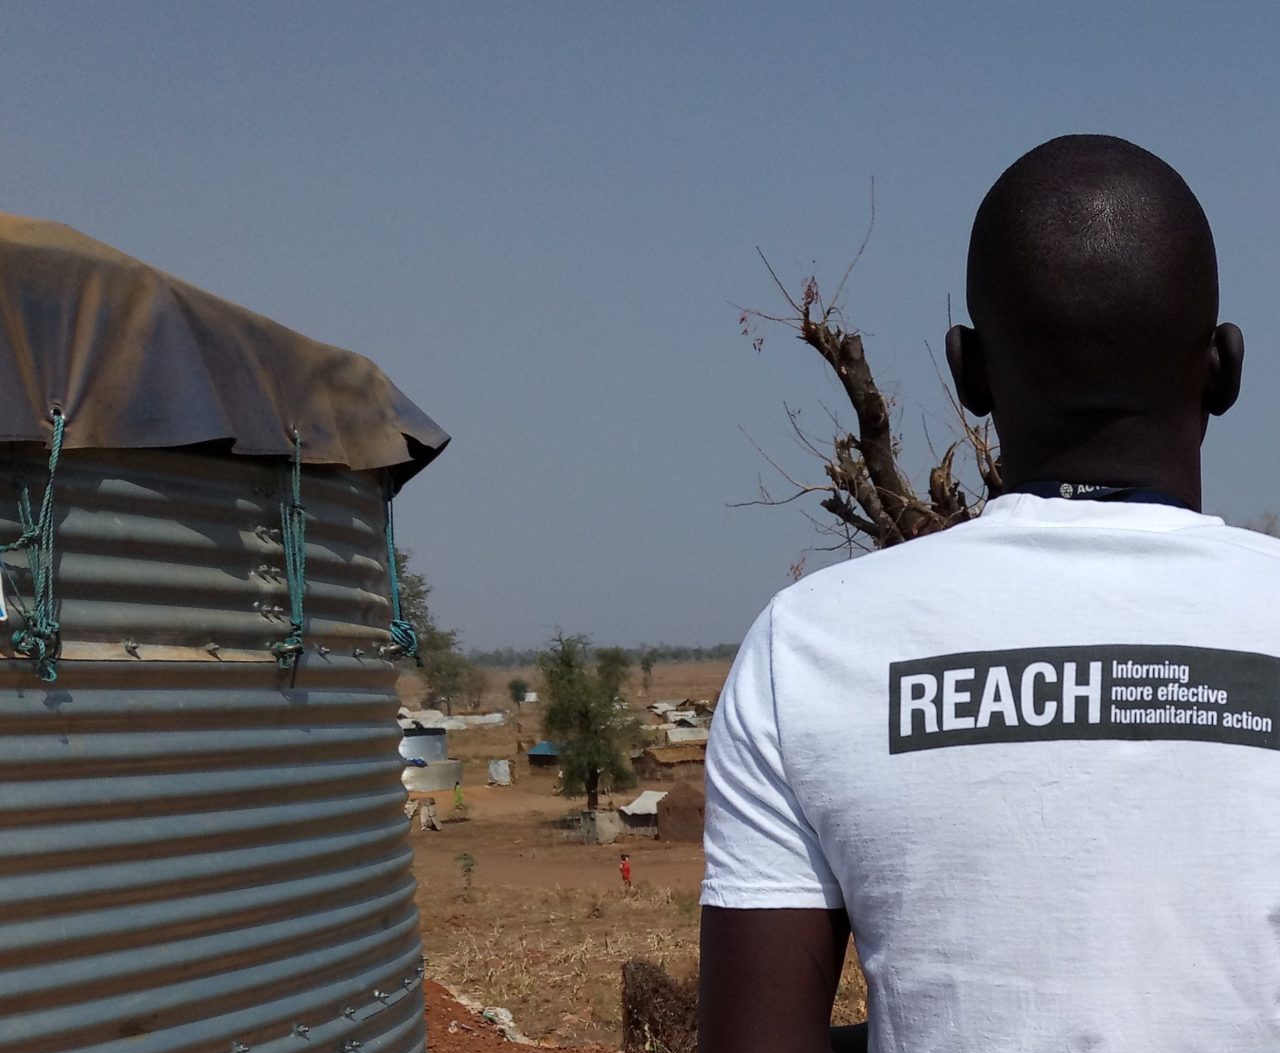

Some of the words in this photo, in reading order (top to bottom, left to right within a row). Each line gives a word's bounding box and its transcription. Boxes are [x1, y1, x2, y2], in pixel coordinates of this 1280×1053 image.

[1112, 660, 1190, 682] Informing
[900, 661, 1102, 737] REACH
[1111, 684, 1153, 702] more
[1157, 683, 1228, 706] effective
[1110, 706, 1218, 727] humanitarian
[1222, 711, 1272, 733] action
